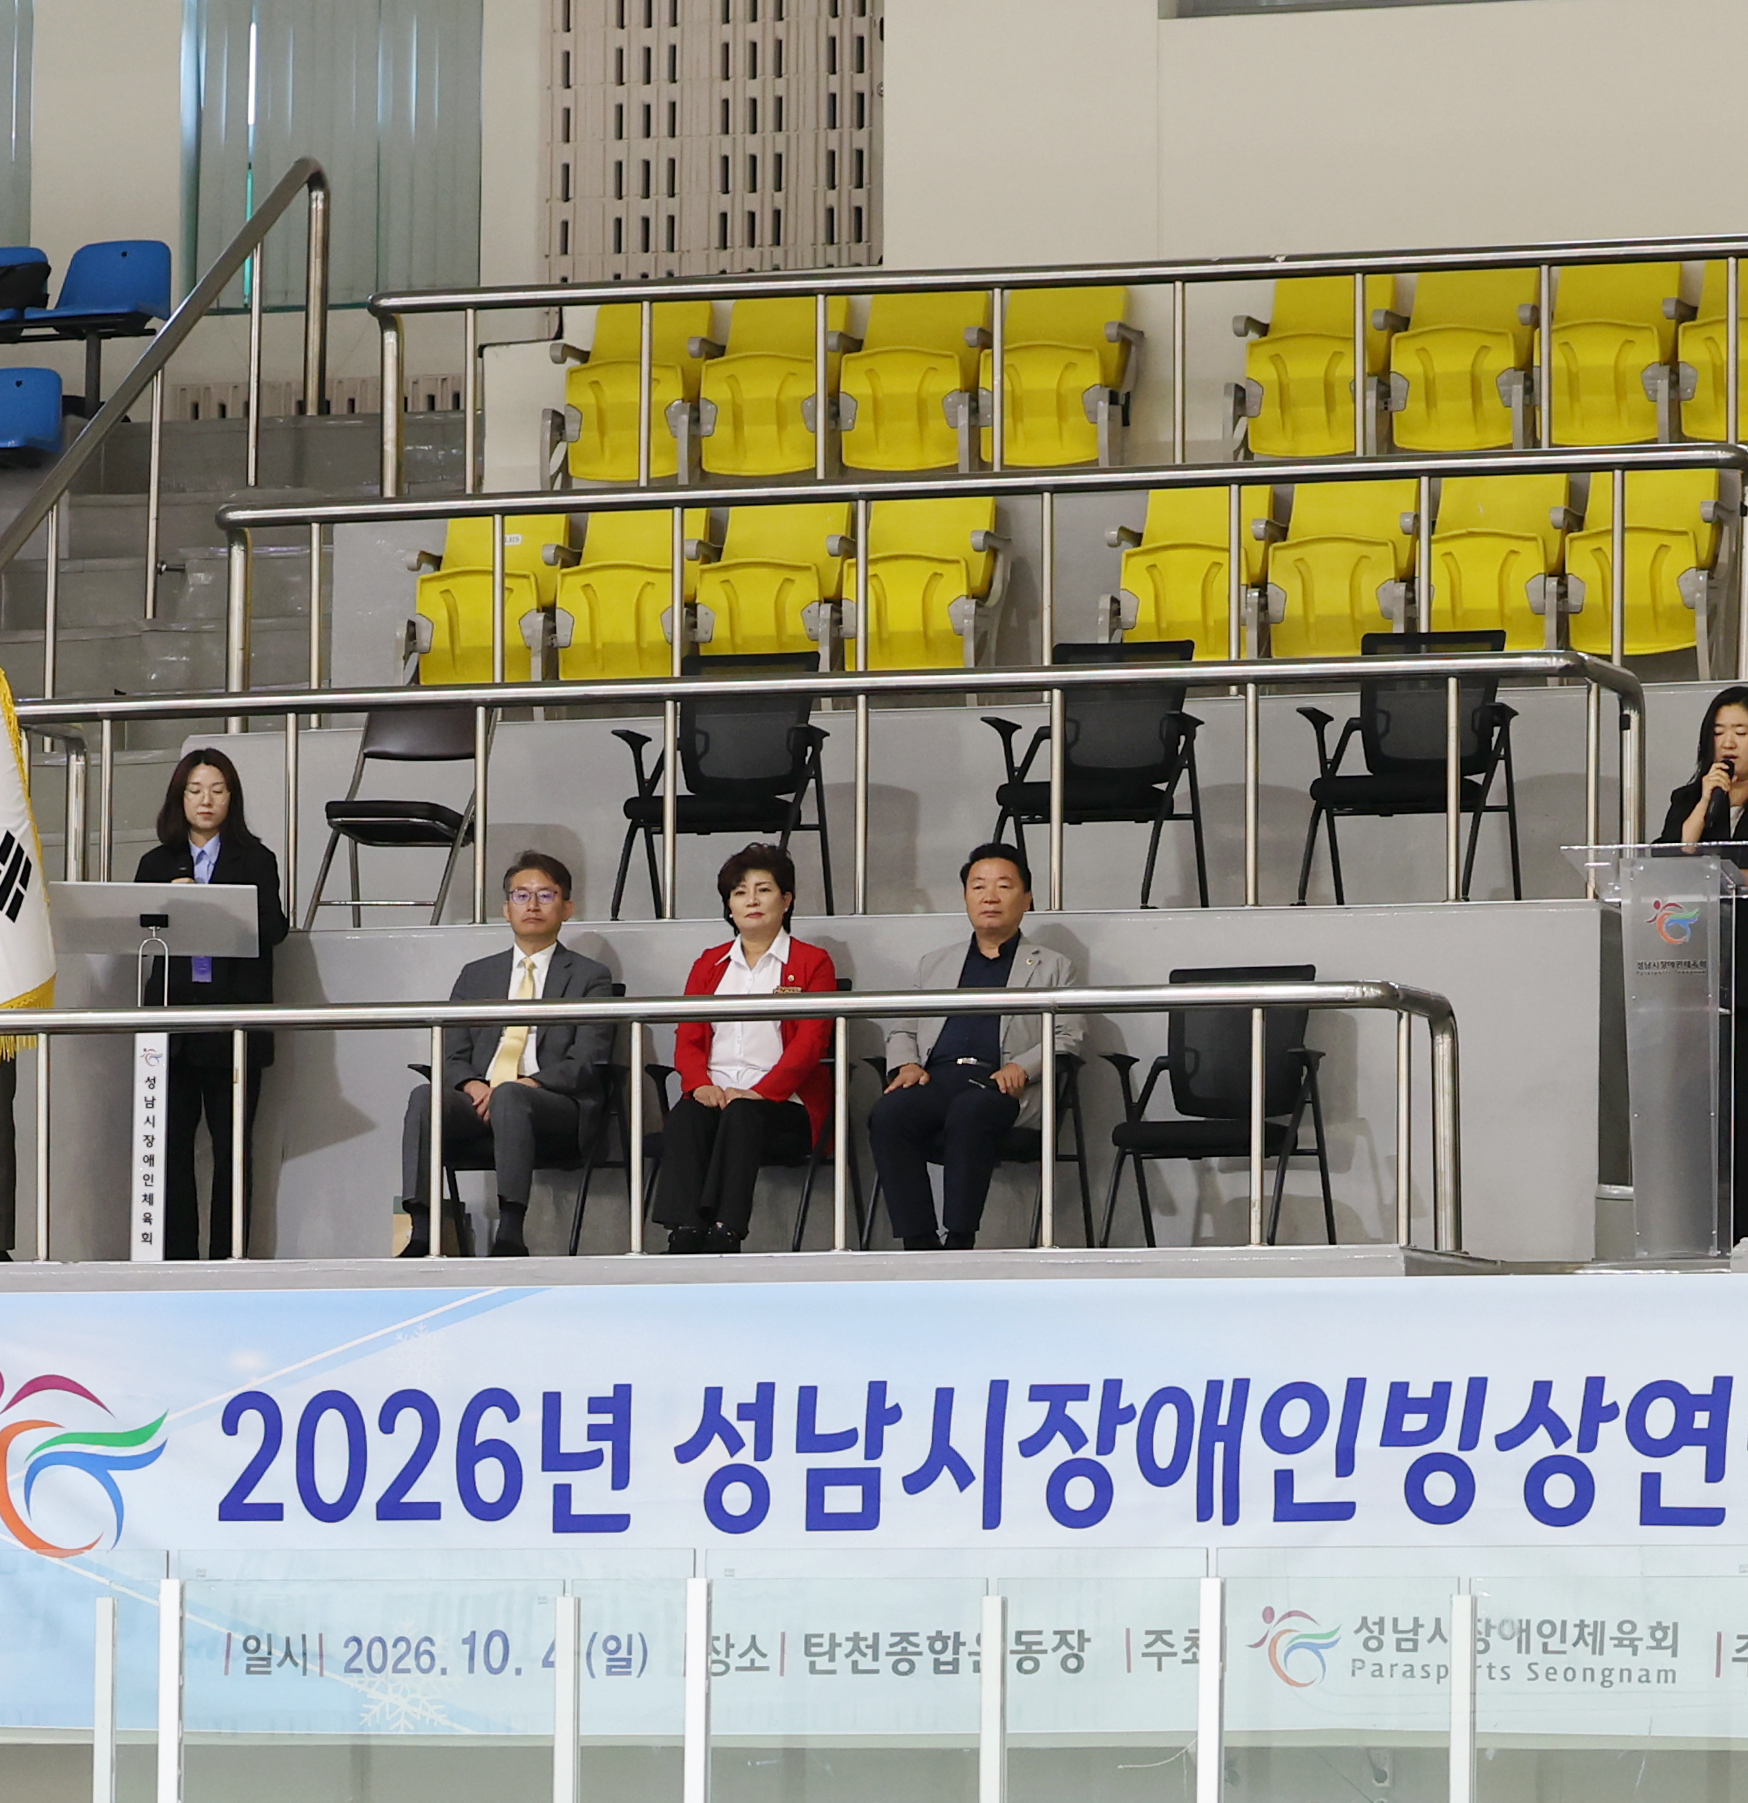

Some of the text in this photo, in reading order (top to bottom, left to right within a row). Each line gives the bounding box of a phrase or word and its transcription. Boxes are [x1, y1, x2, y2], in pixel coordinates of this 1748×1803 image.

[140, 1075, 157, 1246] 성남시장애인체육회
[218, 1382, 633, 1535] 2026년
[241, 1633, 309, 1677] 일시
[341, 1635, 449, 1677] 2026.
[460, 1629, 524, 1677] 10.
[585, 1632, 649, 1679] (일)
[1526, 1661, 1678, 1688] Seongnam
